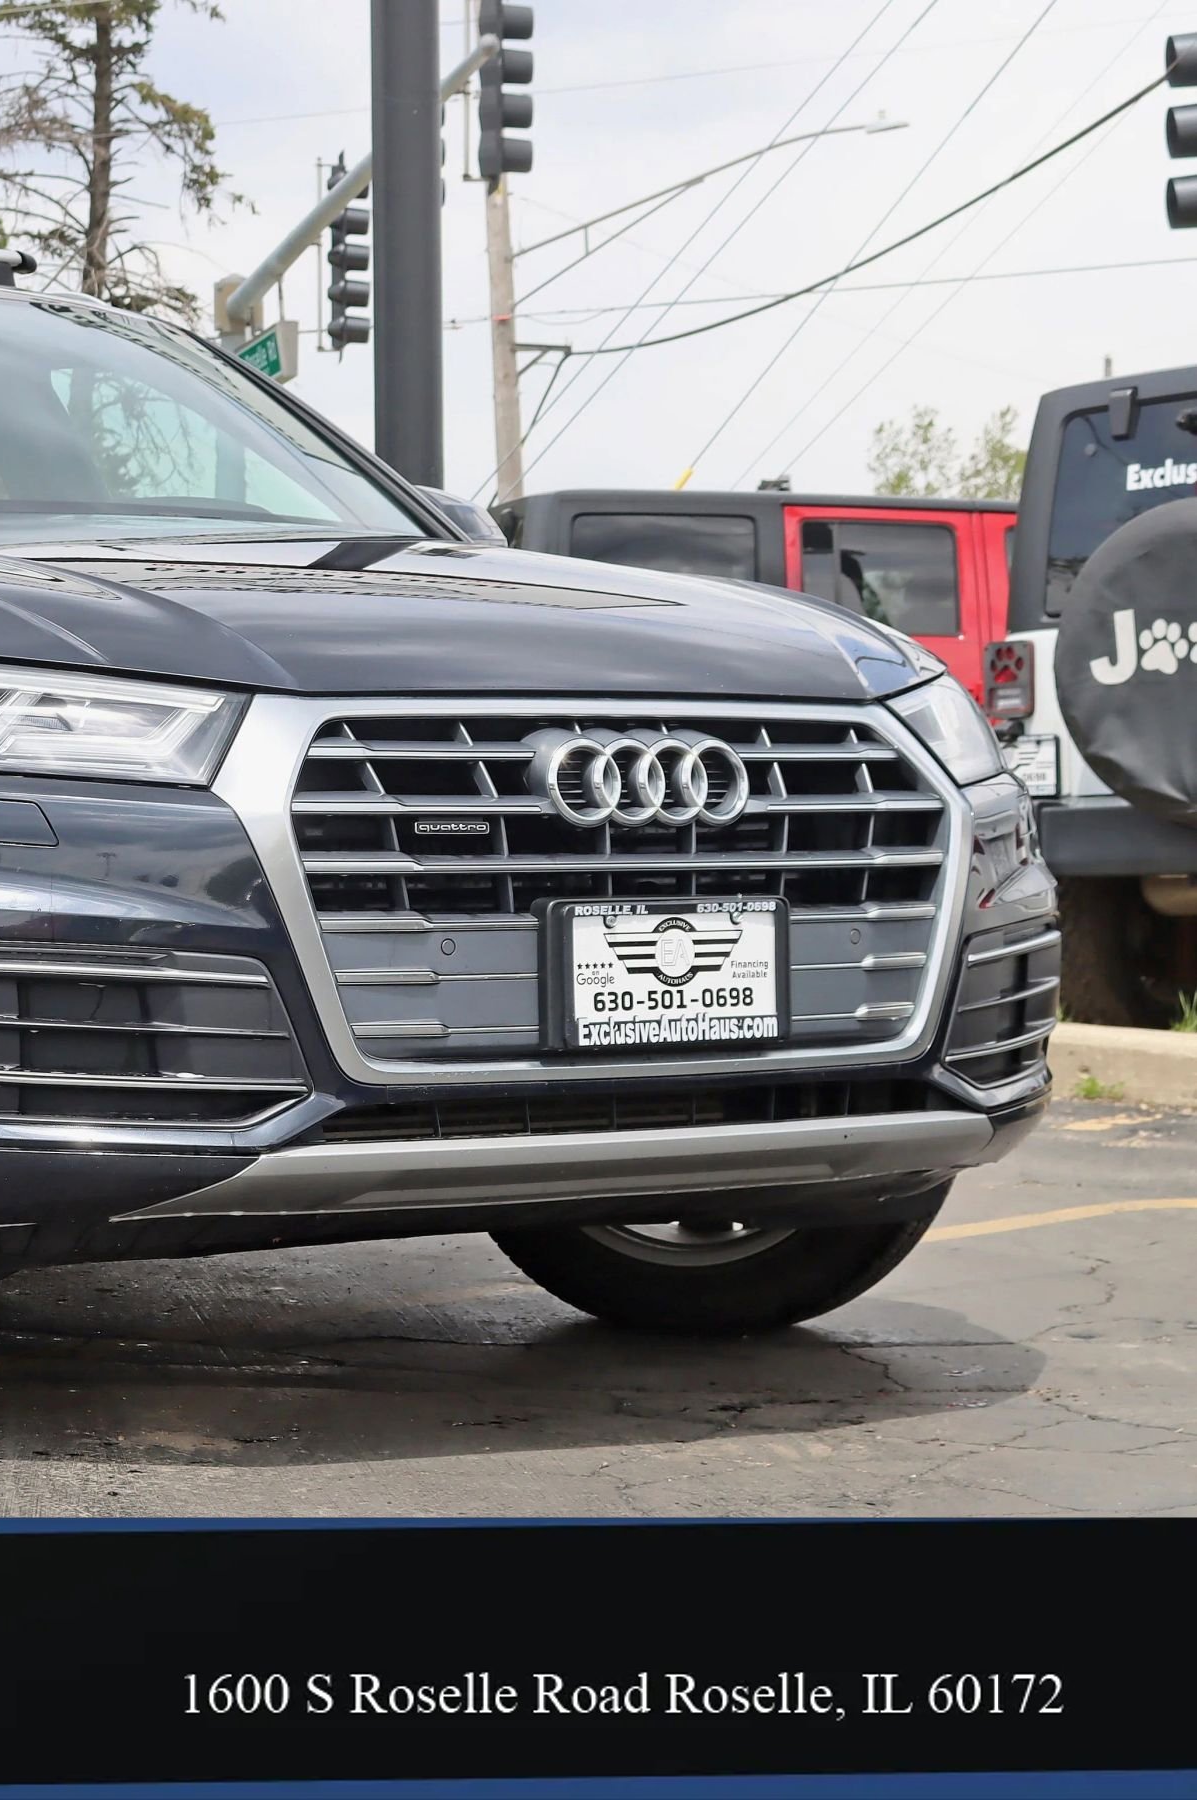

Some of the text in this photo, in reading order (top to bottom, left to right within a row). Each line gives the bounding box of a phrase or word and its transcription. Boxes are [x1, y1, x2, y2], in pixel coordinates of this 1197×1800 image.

[1126, 458, 1197, 491] Exclus
[418, 823, 488, 832] quattro
[574, 904, 649, 916] ROSELLE, IL
[696, 901, 777, 914] 630-501-0698
[658, 919, 692, 932] EXCLUSIVE
[730, 960, 769, 971] Financing
[576, 973, 615, 988] Google
[658, 971, 694, 985] AUTOHAUS
[731, 970, 768, 979] Available
[593, 986, 754, 1013] 630-501-0698
[578, 1013, 779, 1047] ExclusiveAutoHaus.com
